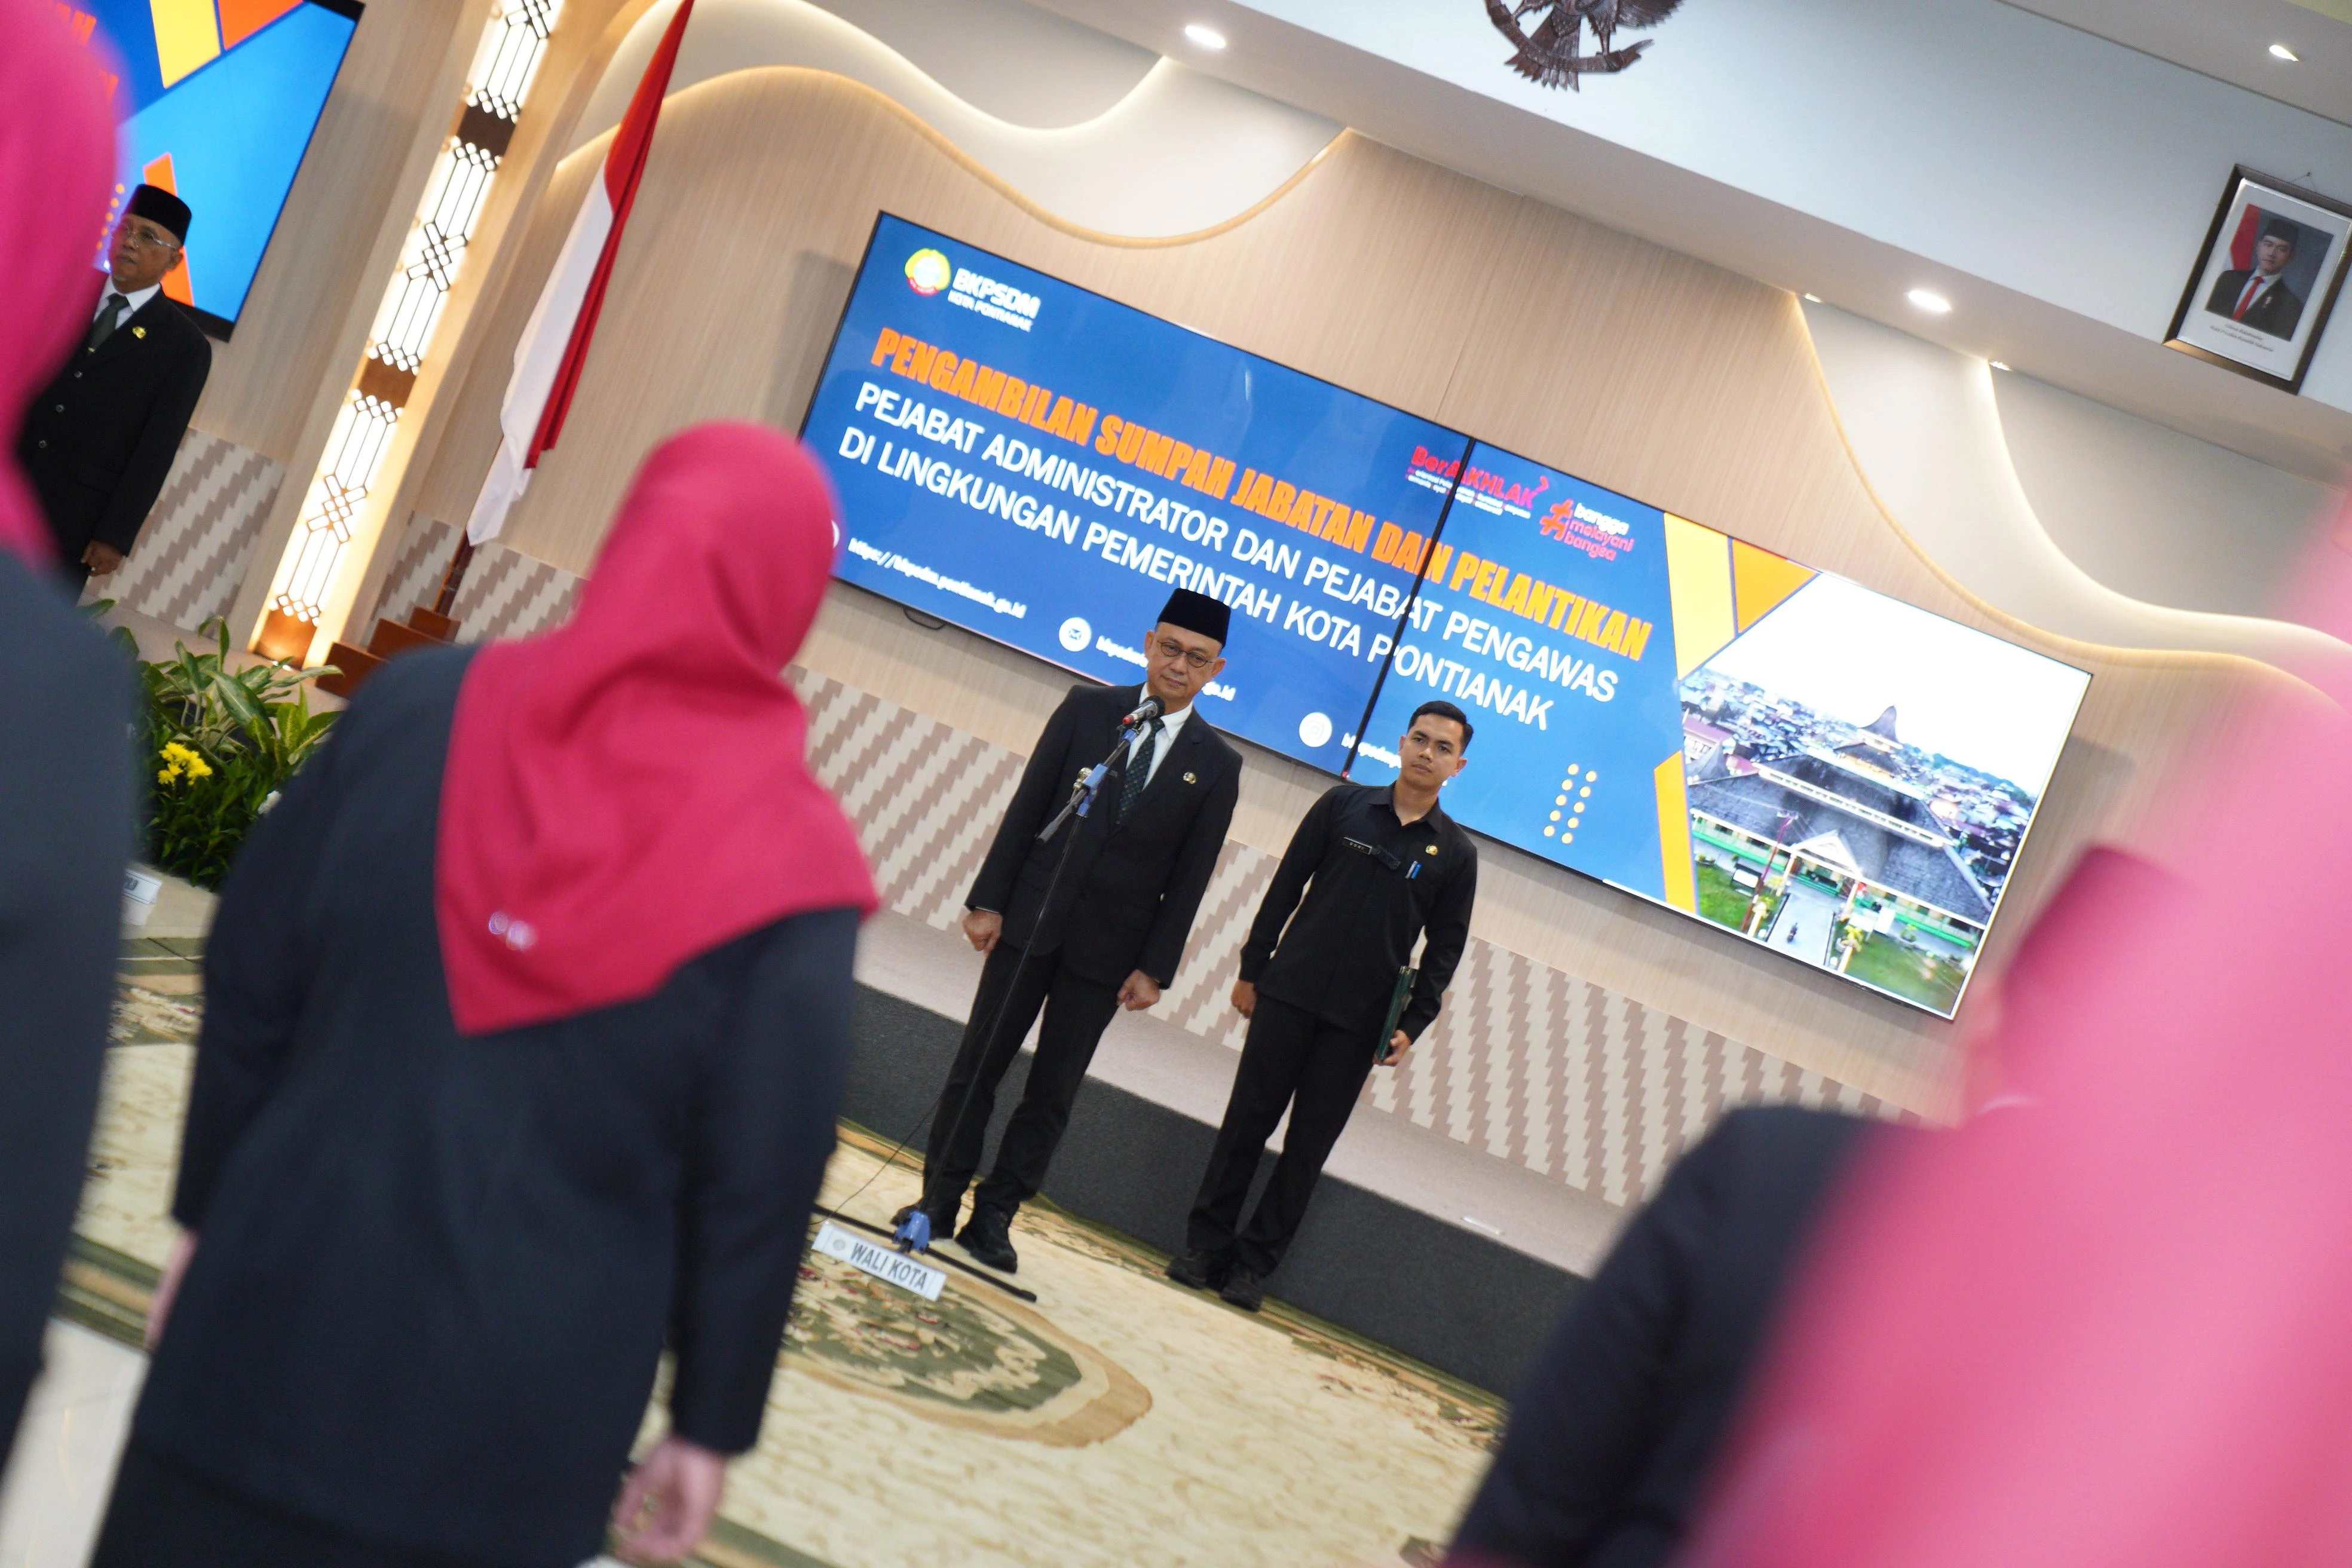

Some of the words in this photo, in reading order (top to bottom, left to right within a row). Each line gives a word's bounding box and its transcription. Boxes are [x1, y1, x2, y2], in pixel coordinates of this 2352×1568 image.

[948, 290, 983, 311] KOTA
[980, 302, 1032, 331] PONTIANAK
[953, 268, 1040, 318] BKPSDM
[872, 328, 1097, 444] PENGAMBILAN
[1095, 415, 1235, 498] SUMPAH
[1232, 470, 1374, 552] JABATAN
[1373, 523, 1451, 581] DAN
[1451, 554, 1650, 658] PELANTIKAN
[855, 382, 984, 453] PEJABAT
[981, 434, 1229, 552] ADMINISTRATOR
[1232, 529, 1301, 579] DAN
[1303, 557, 1440, 632] PEJABAT
[1437, 605, 1618, 702] PENGAWAS
[1569, 520, 1634, 552] melayani
[1573, 503, 1630, 535] bangga
[1564, 531, 1617, 561] bangsa
[839, 427, 875, 464] DI
[877, 442, 1080, 544] LINGKUNGAN
[1082, 522, 1281, 623] PEMERINTAH
[1284, 601, 1360, 657] KOTA
[1367, 633, 1554, 731] PONTIANAK
[850, 1242, 887, 1273] WALI
[887, 1258, 927, 1291] KOTA
